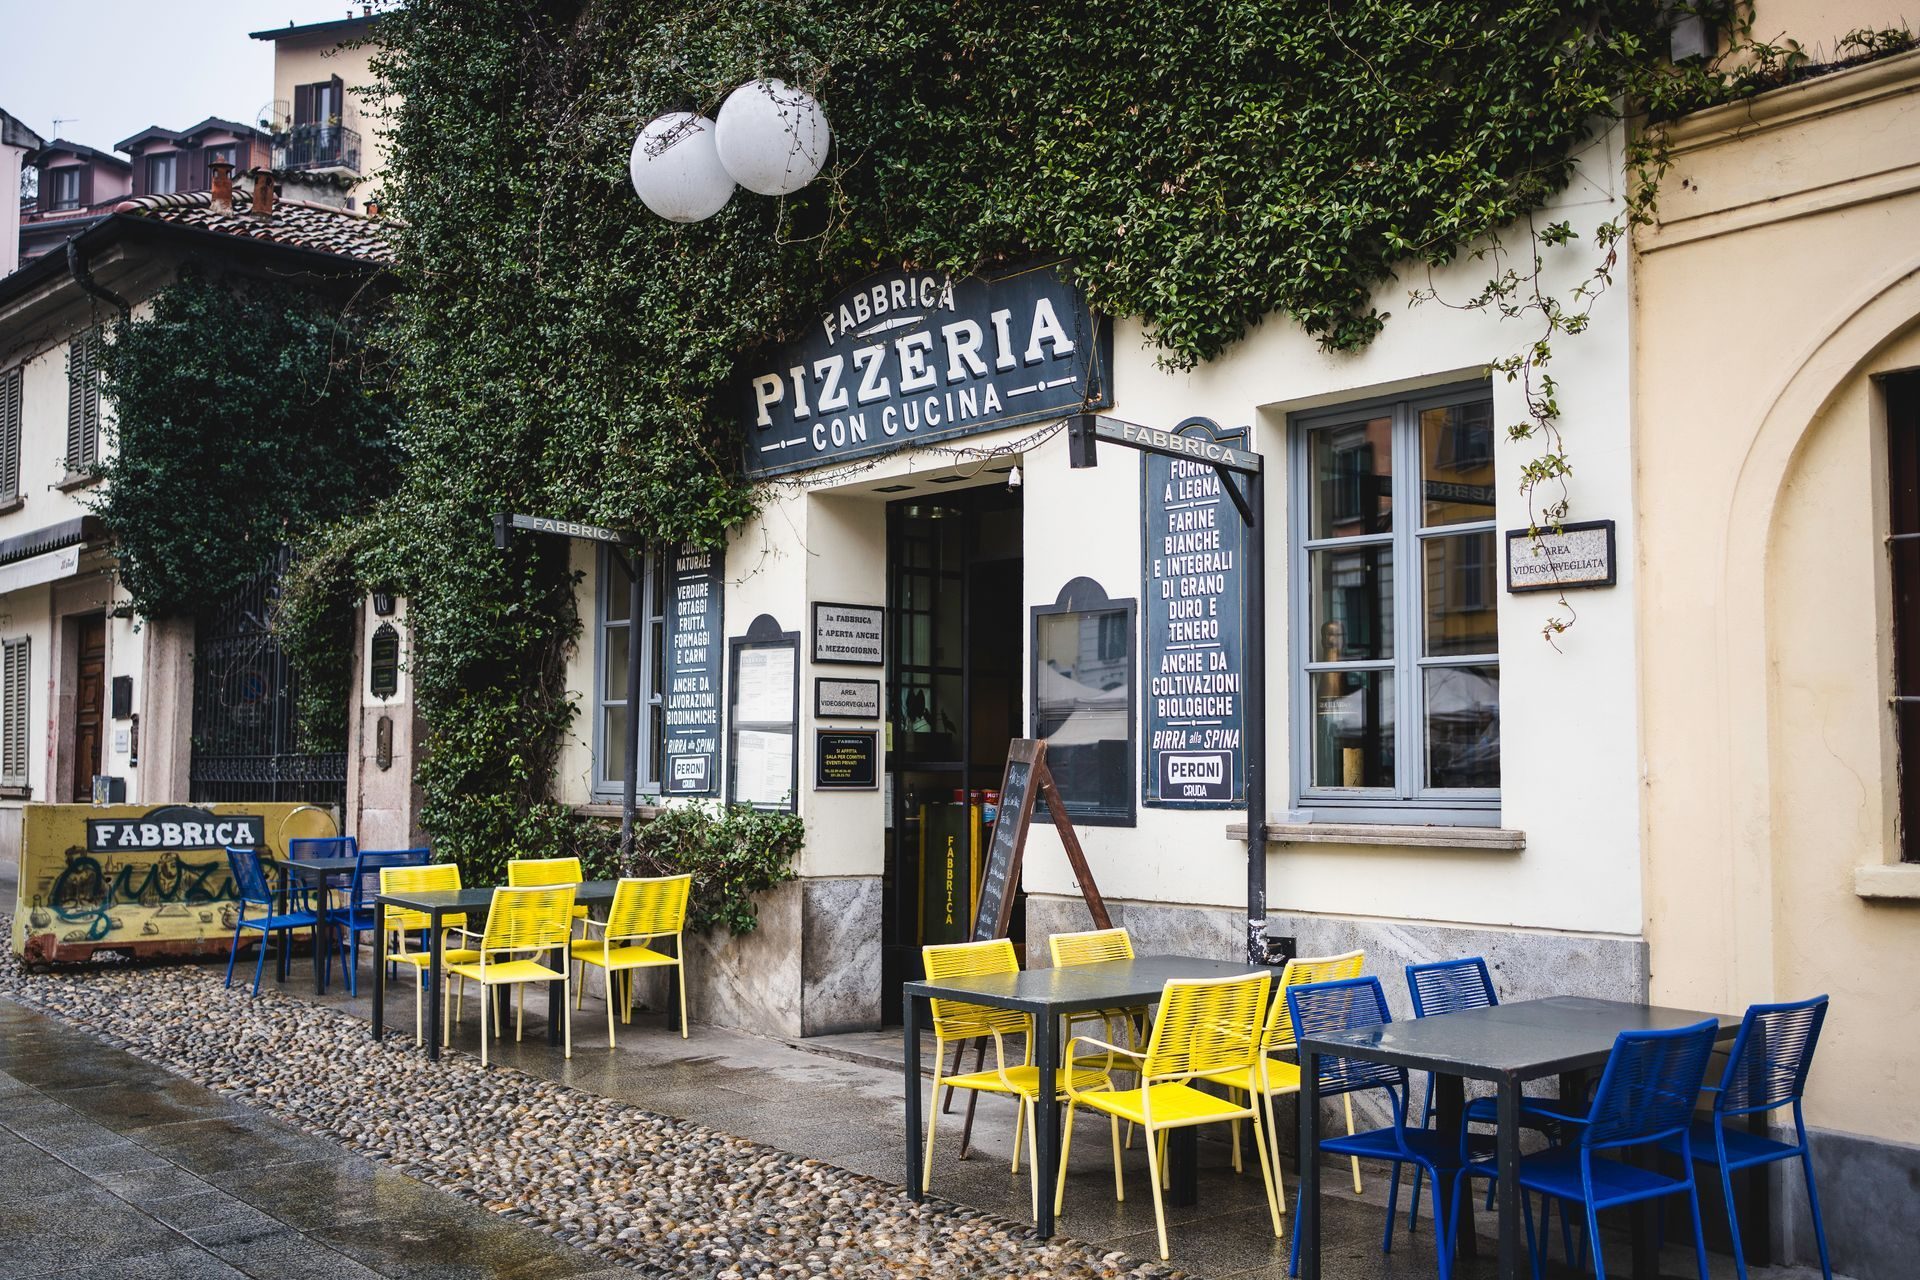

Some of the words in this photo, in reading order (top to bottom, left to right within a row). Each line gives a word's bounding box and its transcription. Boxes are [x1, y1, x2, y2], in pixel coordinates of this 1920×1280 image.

[823, 275, 955, 346] FABBRICA
[752, 297, 1075, 428] PIZZERIA
[811, 414, 867, 451] CON
[882, 382, 1003, 435] CUCINA
[1123, 423, 1237, 465] FABBRICA
[1164, 483, 1173, 503] A
[1179, 476, 1221, 500] LEGNA
[533, 518, 621, 541] FABBRICA
[1168, 508, 1215, 533] FARINE
[1164, 530, 1220, 555] BIANCHE
[1544, 545, 1570, 556] AREA
[676, 554, 711, 572] NATURALE
[1153, 559, 1161, 578] E
[1167, 551, 1233, 576] INTEGRALI
[1513, 559, 1604, 575] VIDEOSORVEGLIATA
[677, 583, 709, 600] VERDURE
[1162, 579, 1174, 599] DI
[1180, 574, 1224, 597] GRANO
[678, 599, 707, 616] ORTAGGI
[1169, 599, 1202, 620] DURO
[1209, 597, 1217, 616] E
[679, 616, 705, 631] FRUTTA
[836, 615, 872, 624] FABBRICA
[825, 630, 853, 638] APERTA
[855, 631, 880, 640] ANCHE
[1168, 619, 1219, 641] TENERO
[674, 632, 710, 648] FORMAGGI
[677, 650, 682, 664] E
[684, 648, 706, 663] CARNI
[825, 645, 880, 655] MEZZOGIORNO.
[1161, 653, 1203, 674] ANCHE
[1209, 651, 1228, 672] DA
[673, 678, 696, 692] ANCHE
[699, 676, 709, 691] DA
[1152, 673, 1239, 696] COLTIVAZIONI
[668, 693, 715, 709] LAVORAZIONI
[820, 700, 876, 708] VIDEOSORVEGLIATA
[1158, 696, 1233, 718] BIOLOGICHE
[666, 710, 717, 725] BIODINAMICHE
[667, 739, 687, 753] BIRRA
[695, 738, 715, 753] SPINA
[1153, 730, 1186, 749] BIRRA
[1189, 731, 1202, 744] alla
[1203, 729, 1240, 749] SPINA
[676, 763, 703, 775] PERONI
[1171, 762, 1220, 778] PERONI
[1183, 784, 1207, 797] CRUDA
[95, 822, 255, 847] FABBRICA
[945, 836, 954, 924] FABBRICA
